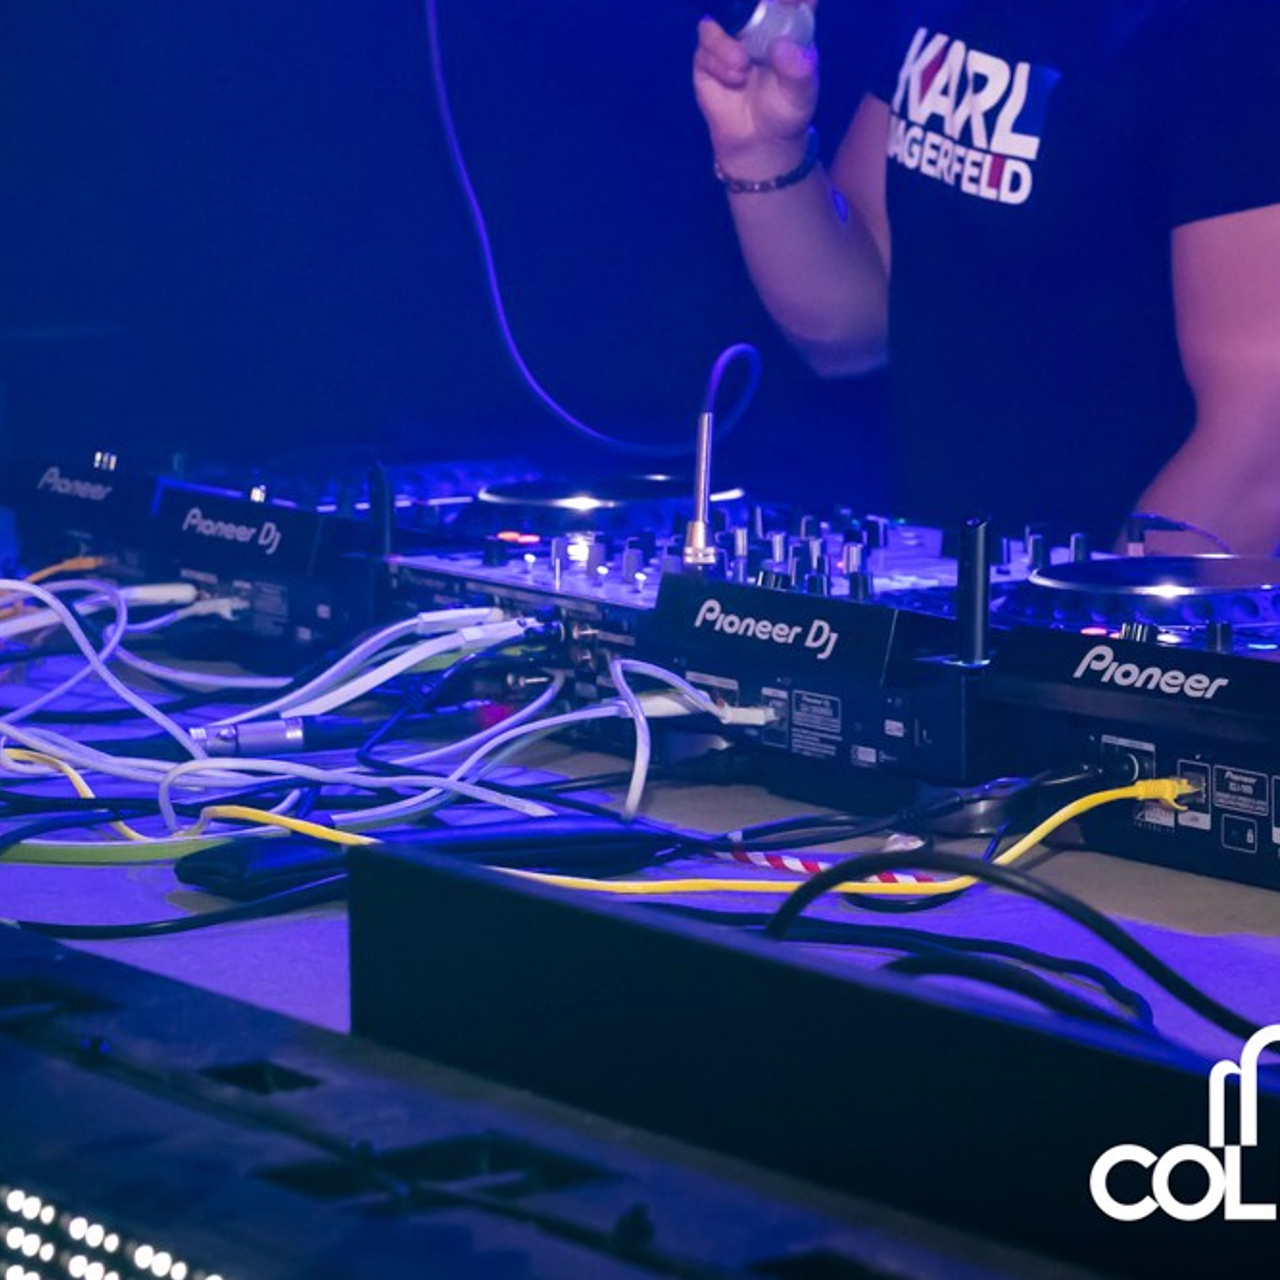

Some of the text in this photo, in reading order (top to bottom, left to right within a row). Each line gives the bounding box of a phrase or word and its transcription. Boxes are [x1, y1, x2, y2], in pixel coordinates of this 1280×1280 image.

[892, 27, 1041, 161] KARL
[37, 467, 112, 501] Pioneer
[182, 507, 256, 542] Pioneer
[694, 599, 802, 644] Pioneer
[1073, 644, 1229, 699] Pioneer
